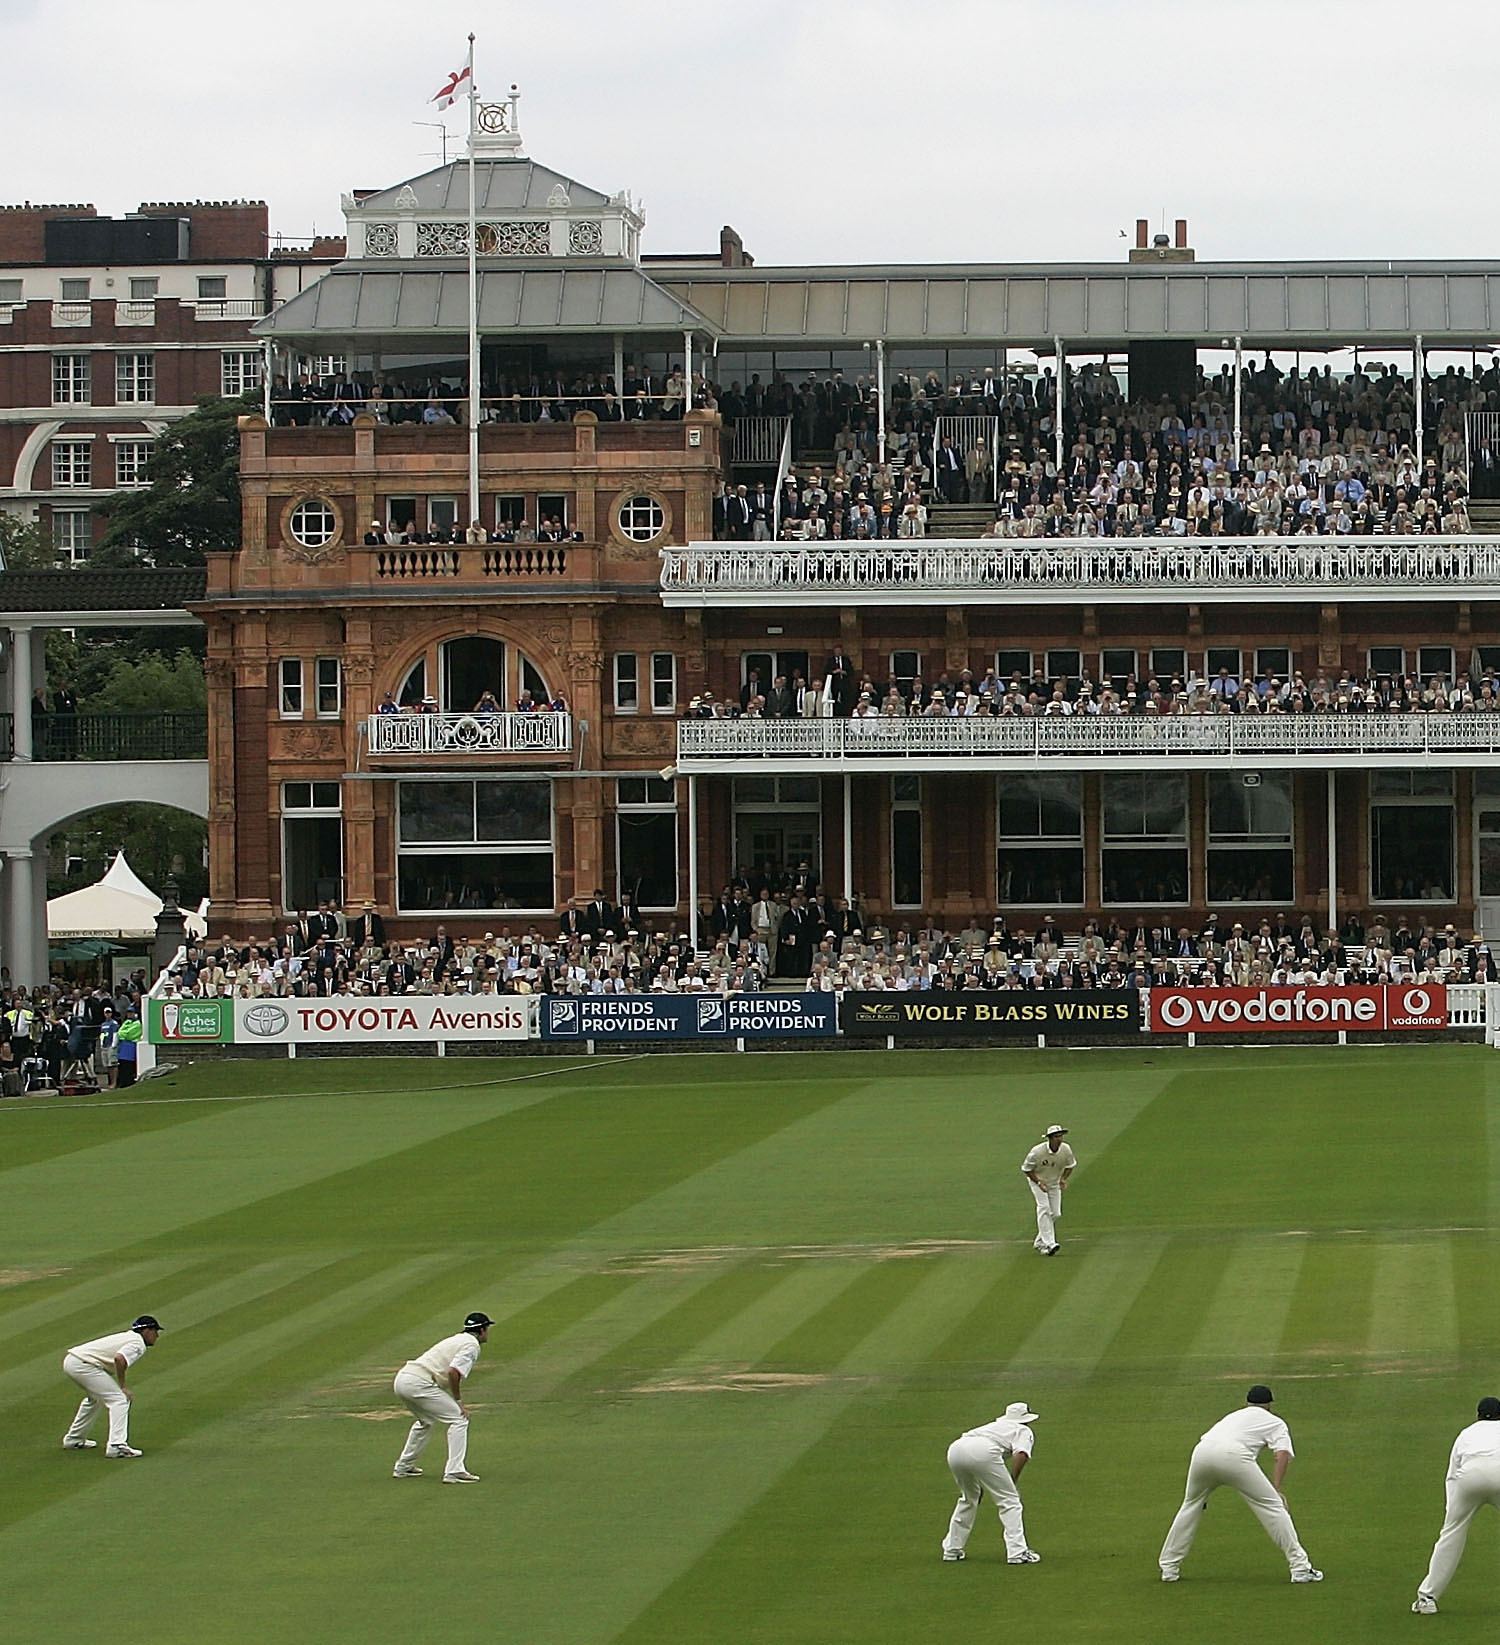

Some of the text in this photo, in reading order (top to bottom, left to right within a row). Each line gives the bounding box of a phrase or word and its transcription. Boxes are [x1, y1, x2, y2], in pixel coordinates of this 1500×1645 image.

[582, 1002, 654, 1015] FRIENDS
[729, 1000, 801, 1013] FRIENDS
[903, 1003, 1129, 1021] WOLF BLASS WINES
[1197, 990, 1377, 1022] vodafone
[183, 1015, 216, 1026] Ashes
[298, 1006, 523, 1031] TOYOTA Avensis
[582, 1018, 679, 1032] PROVIDENT
[729, 1015, 826, 1030] PROVIDENT
[1391, 1015, 1442, 1025] vodafone
